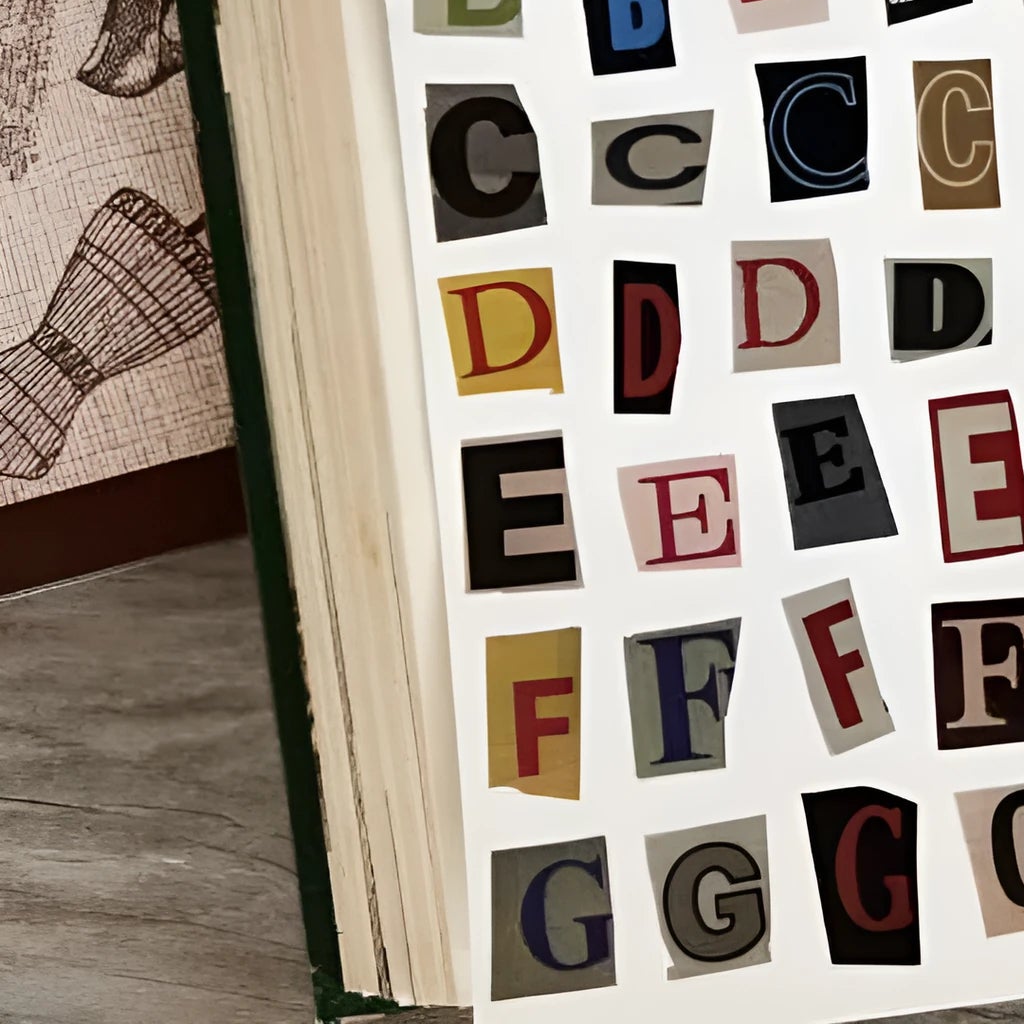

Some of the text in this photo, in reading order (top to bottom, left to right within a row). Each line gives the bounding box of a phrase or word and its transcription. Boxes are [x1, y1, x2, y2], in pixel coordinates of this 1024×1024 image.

[430, 96, 541, 218] C
[605, 124, 707, 189] C
[770, 72, 869, 189] C
[918, 70, 992, 186] C
[449, 280, 553, 379] D
[623, 283, 677, 398] D
[738, 258, 819, 349] D
[894, 267, 986, 351] D
[463, 437, 577, 589] E
[645, 467, 736, 564] E
[782, 415, 864, 505] E
[939, 403, 1021, 552] E
[513, 677, 572, 776] F
[639, 628, 736, 765] F
[802, 600, 863, 729] F
[521, 859, 612, 971] G
[663, 841, 763, 960] G
[835, 804, 913, 931] G
